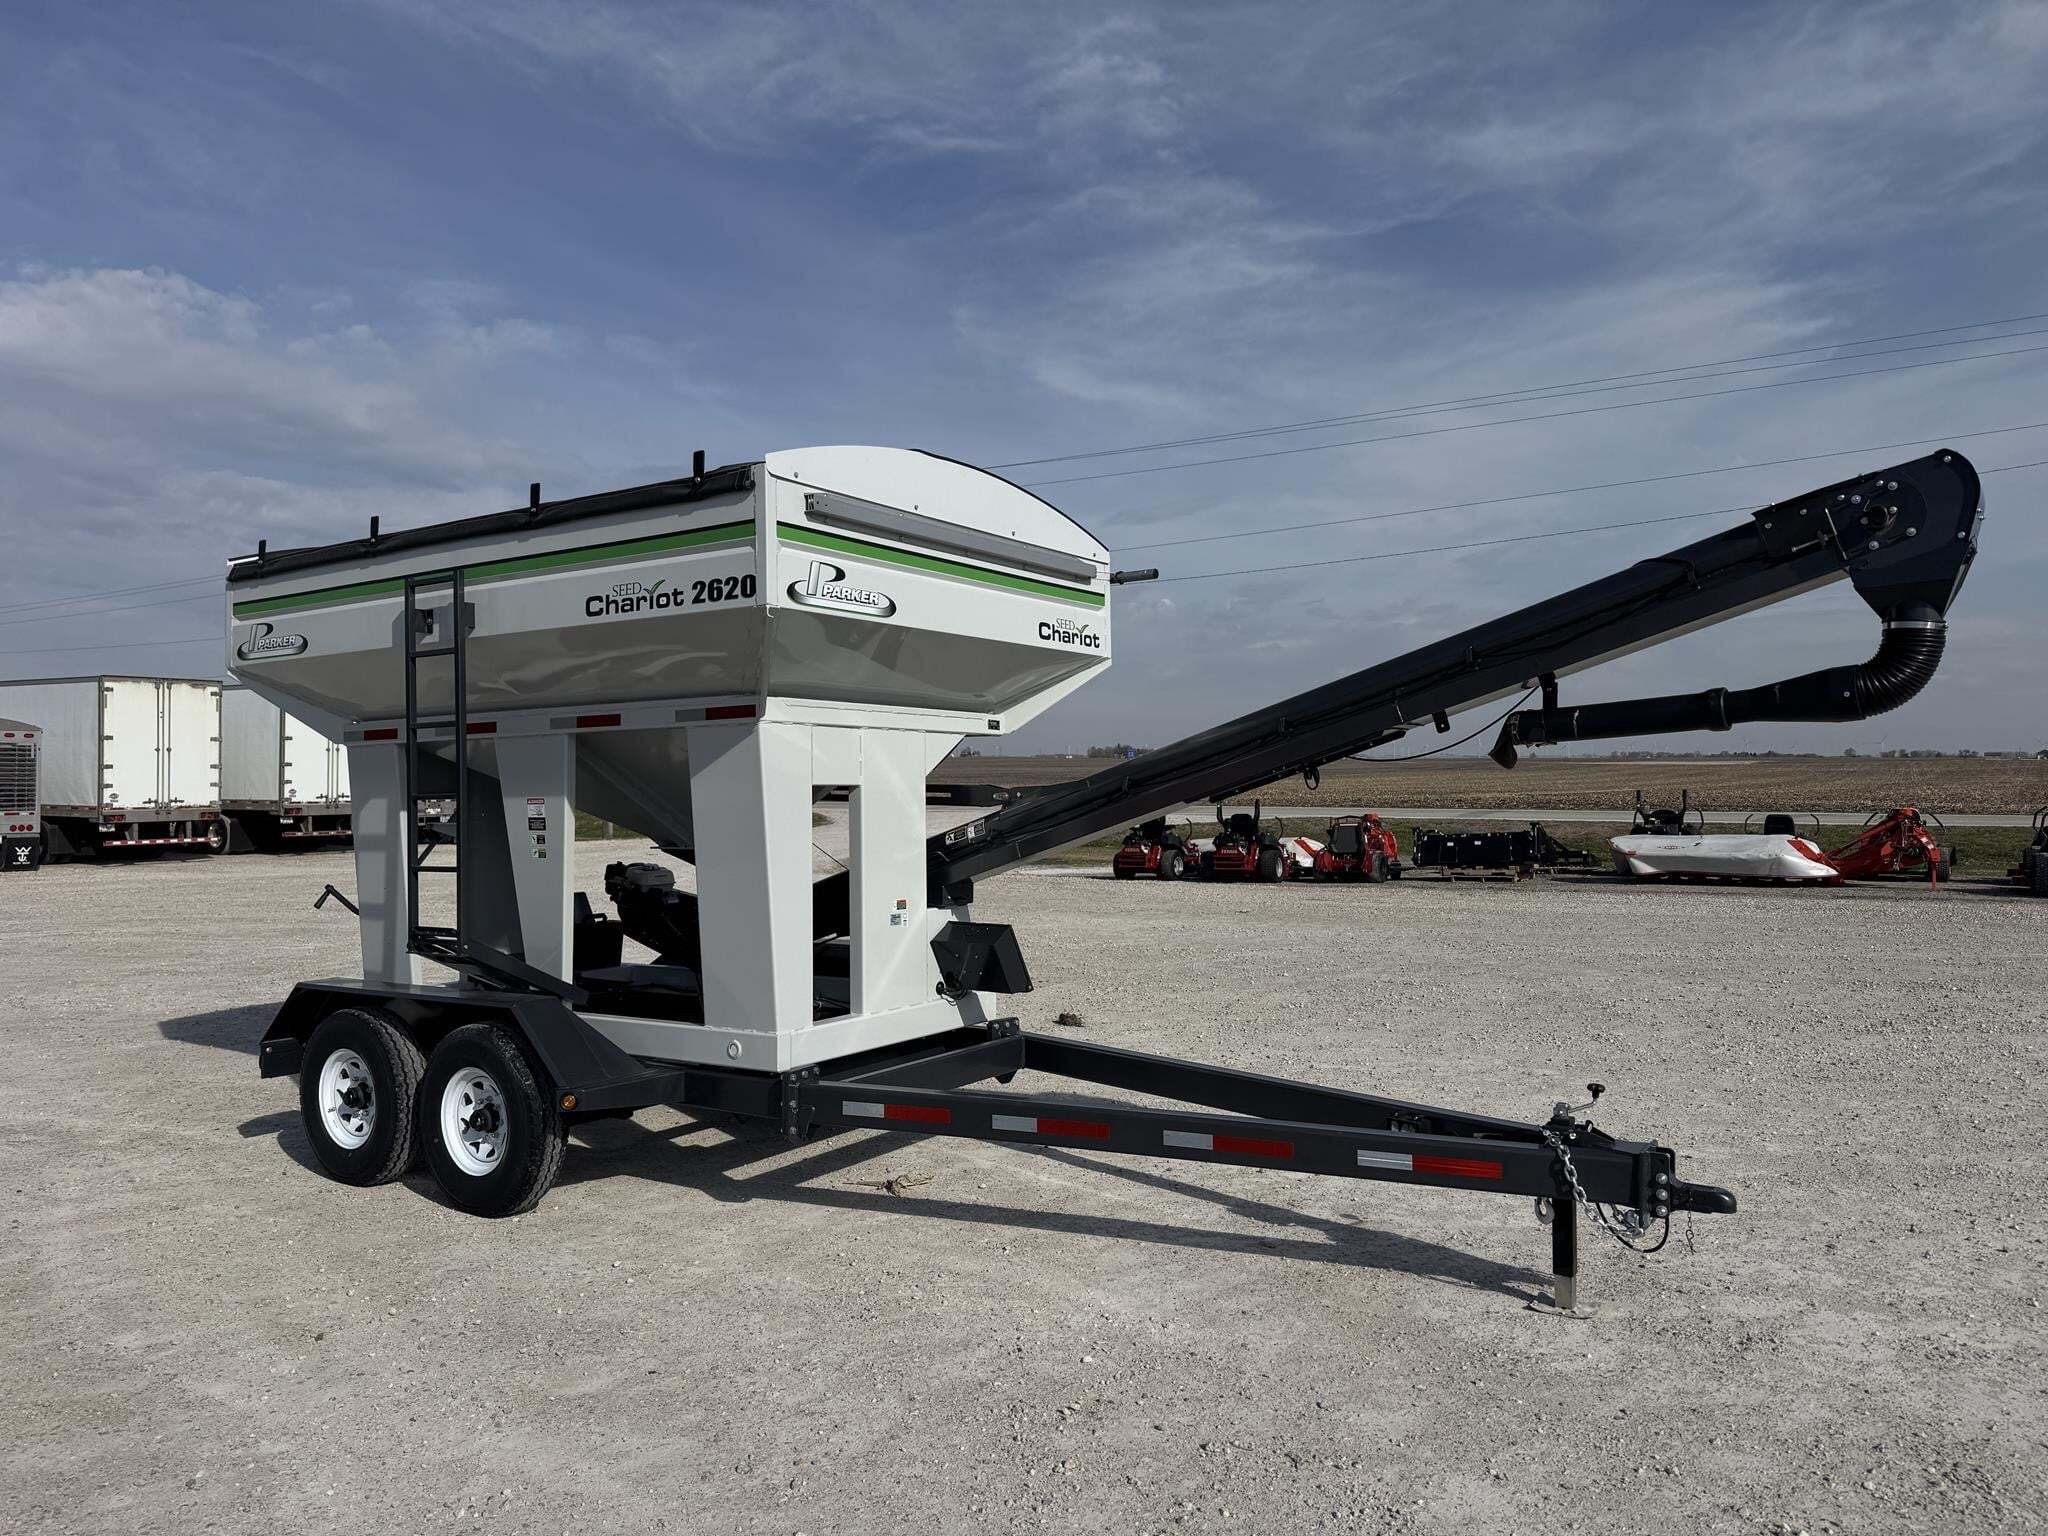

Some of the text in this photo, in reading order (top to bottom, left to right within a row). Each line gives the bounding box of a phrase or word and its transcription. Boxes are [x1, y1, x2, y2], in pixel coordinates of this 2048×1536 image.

[585, 574, 757, 617] Chariot 2620
[612, 582, 642, 597] SEED
[822, 584, 880, 606] PARKER
[1056, 618, 1076, 631] SEED
[257, 635, 296, 651] PARKER
[1039, 621, 1100, 649] Chariot
